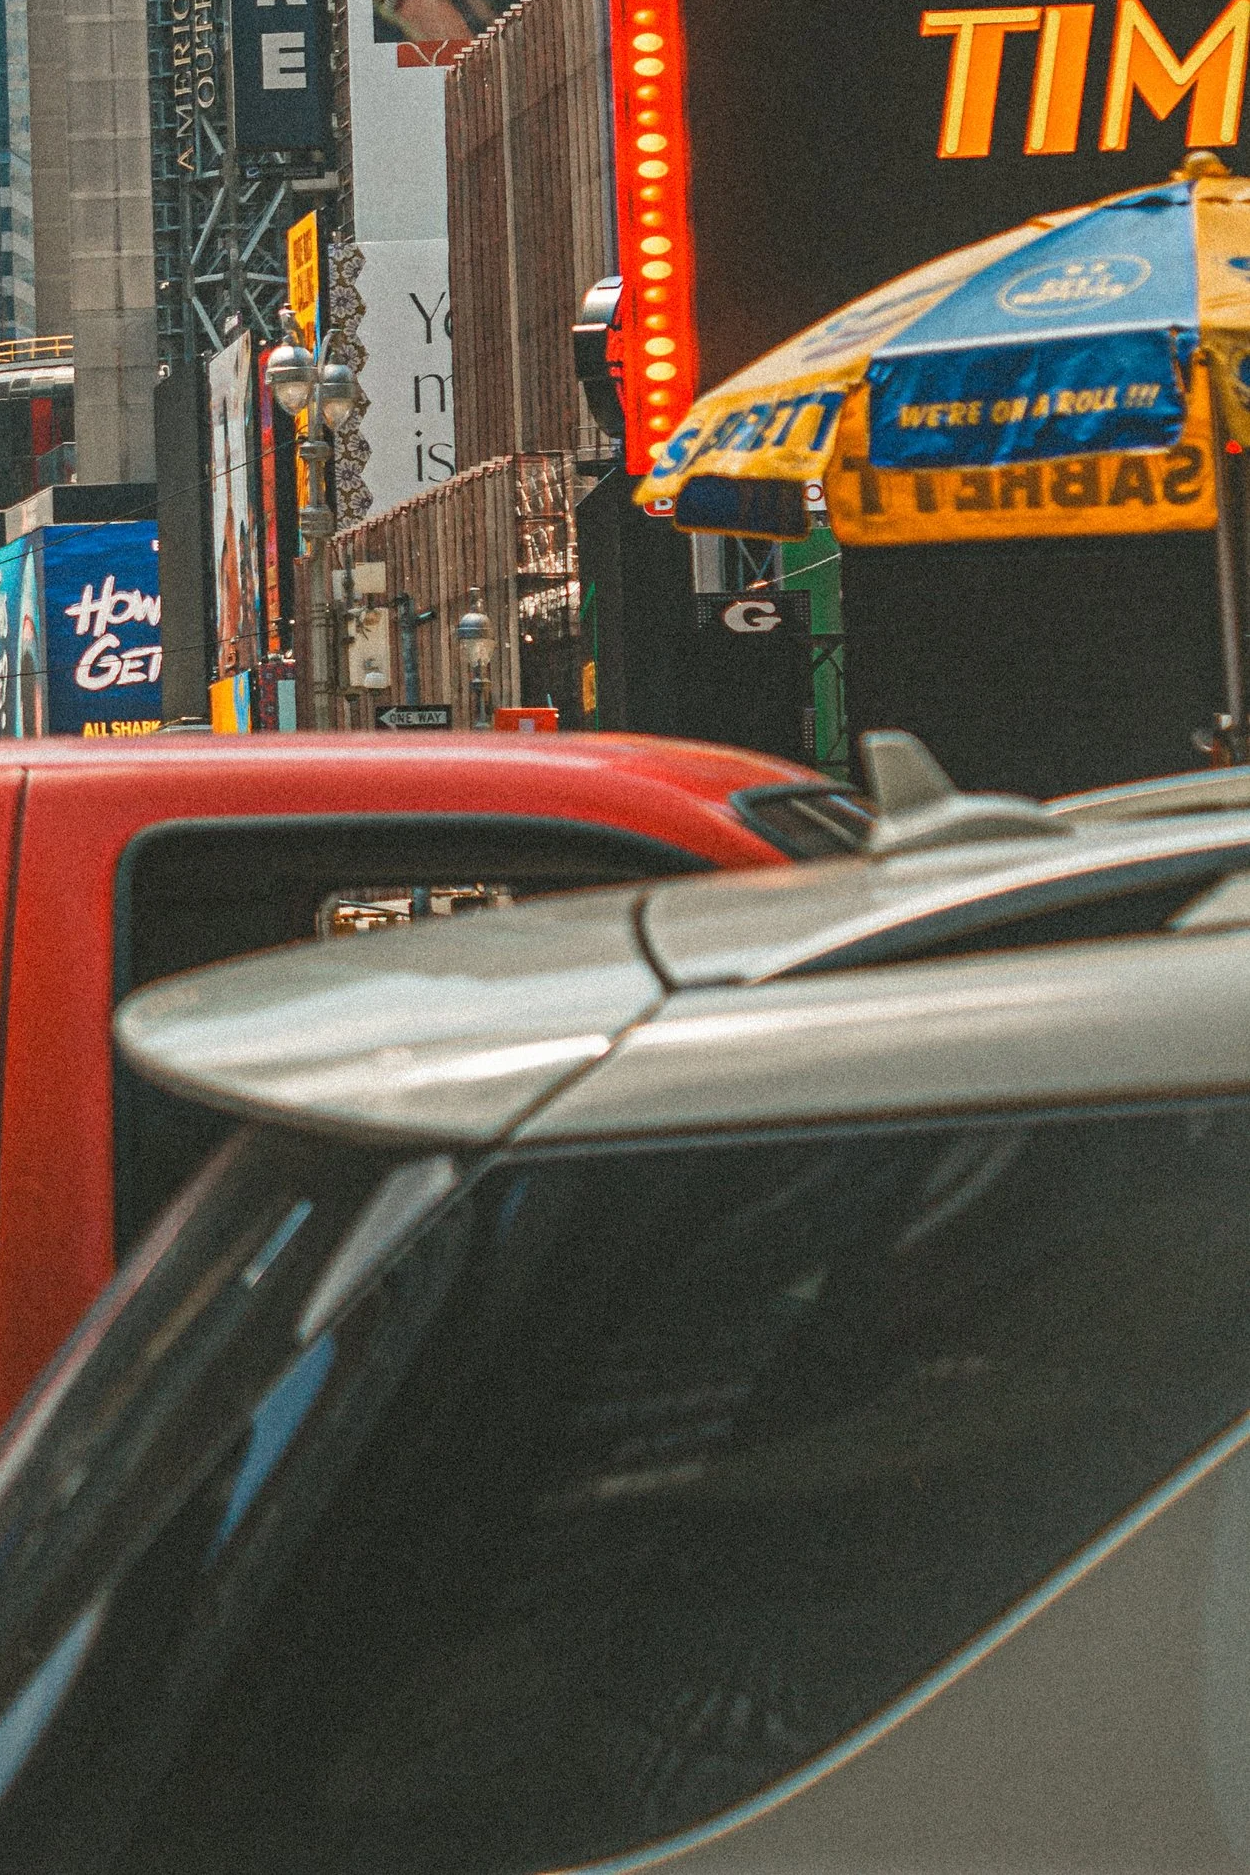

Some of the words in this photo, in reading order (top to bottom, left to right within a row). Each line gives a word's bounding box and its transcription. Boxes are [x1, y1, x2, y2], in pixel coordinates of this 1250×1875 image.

[390, 712, 413, 724] ONE
[417, 712, 442, 724] WAY
[83, 722, 109, 739] ALL
